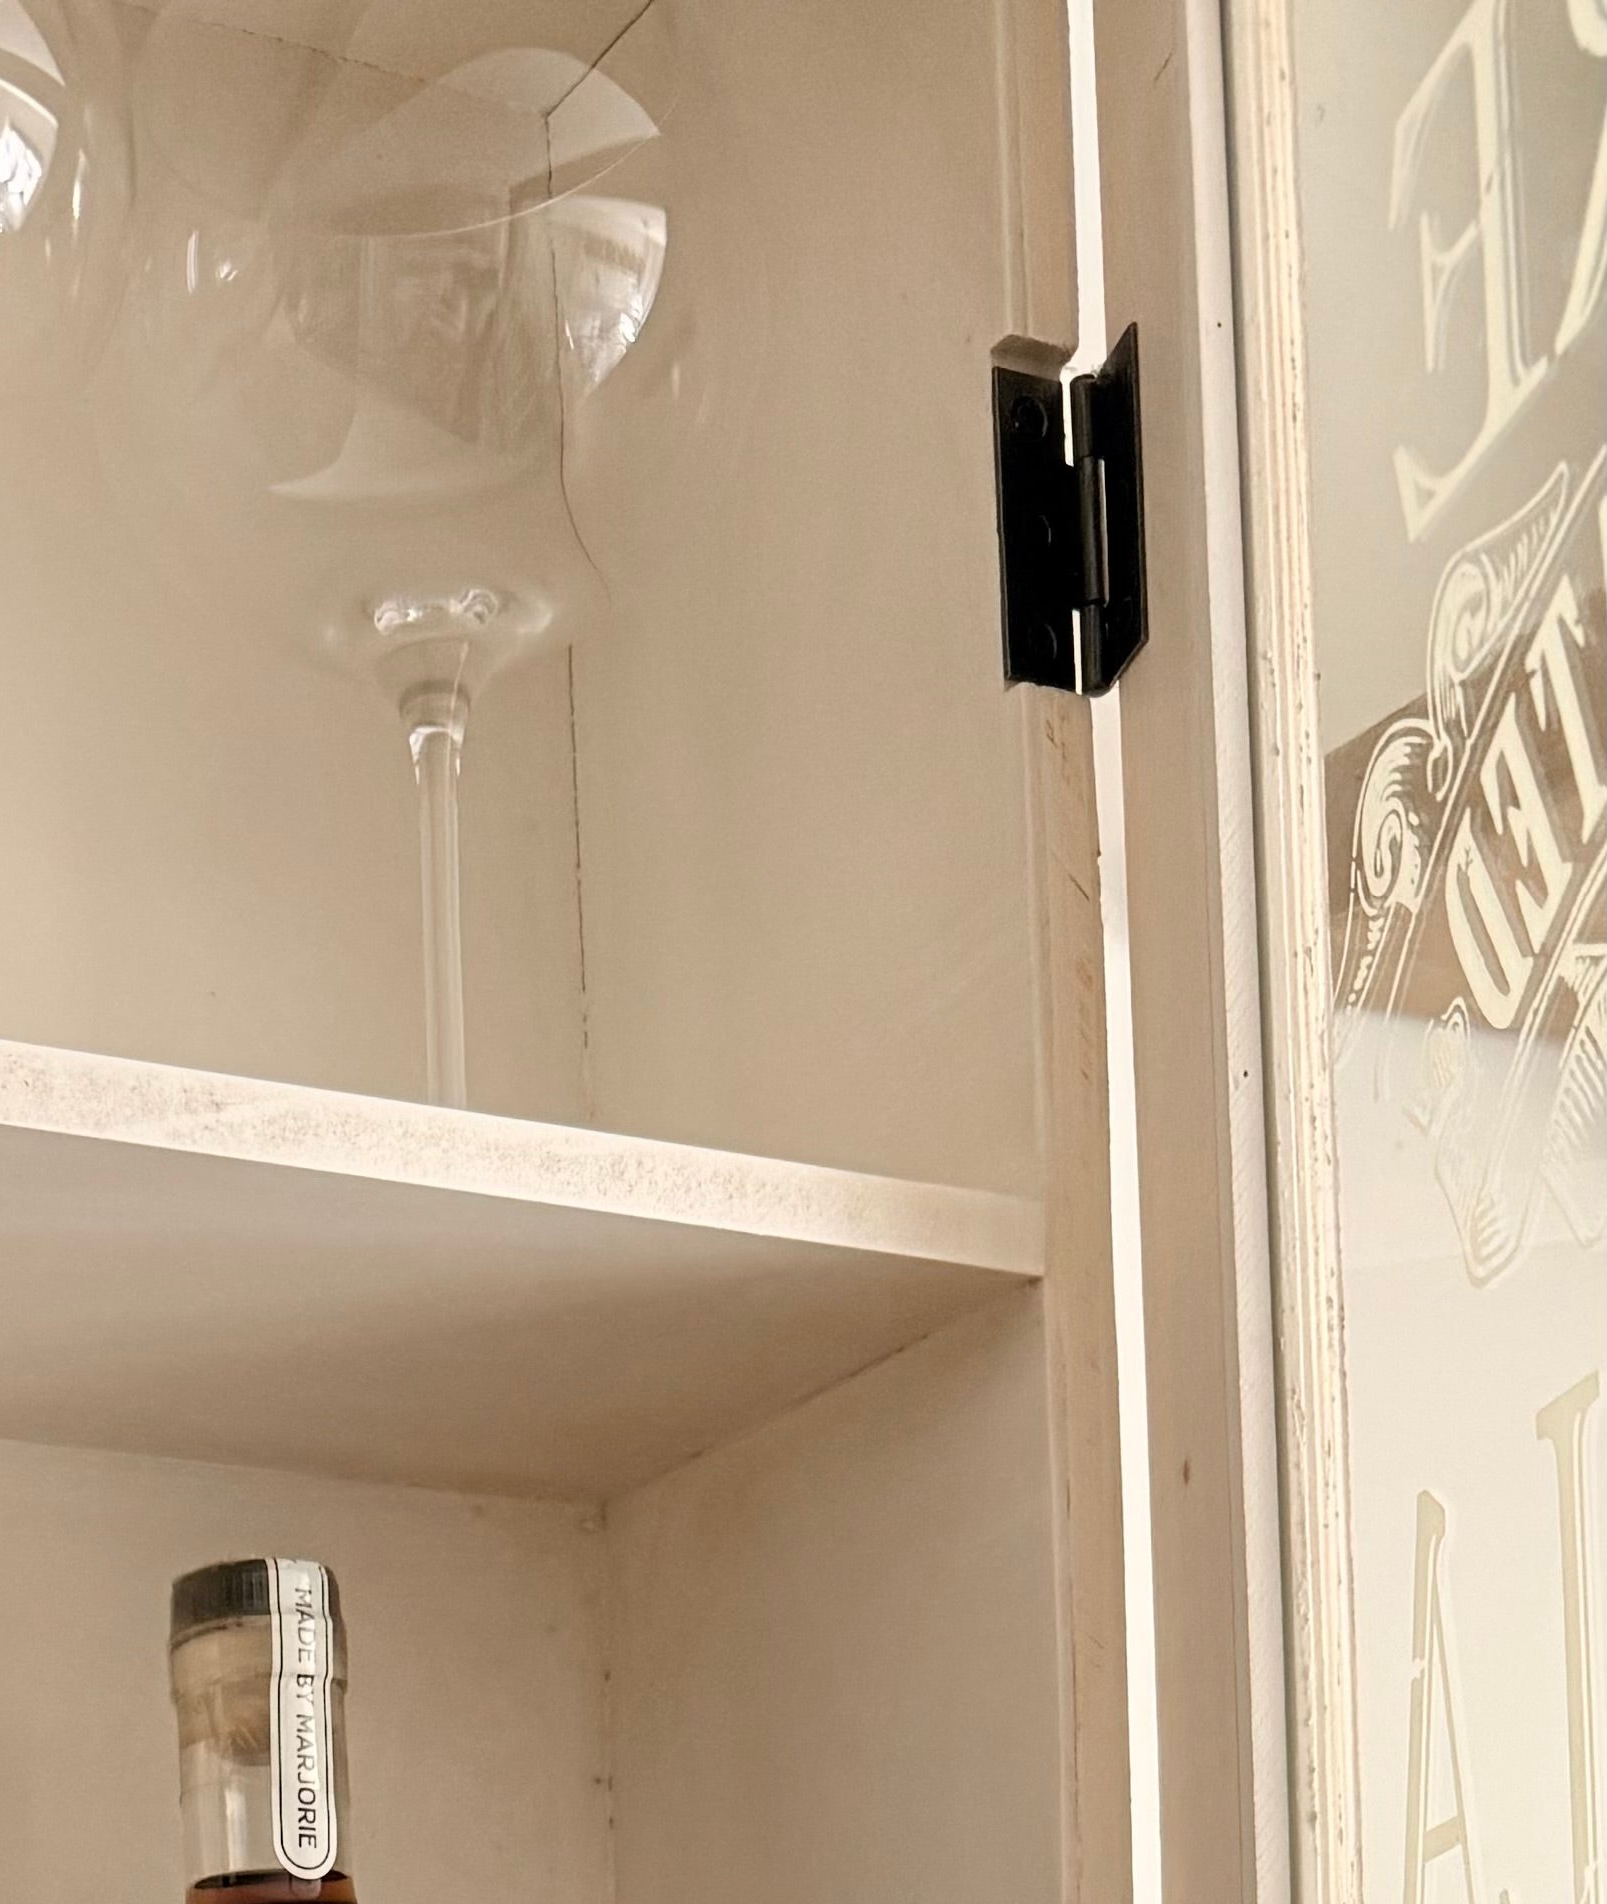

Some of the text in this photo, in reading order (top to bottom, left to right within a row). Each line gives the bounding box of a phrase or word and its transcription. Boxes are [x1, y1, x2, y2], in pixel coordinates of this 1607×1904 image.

[294, 1587, 318, 1849] MADE BY MARJORIE
